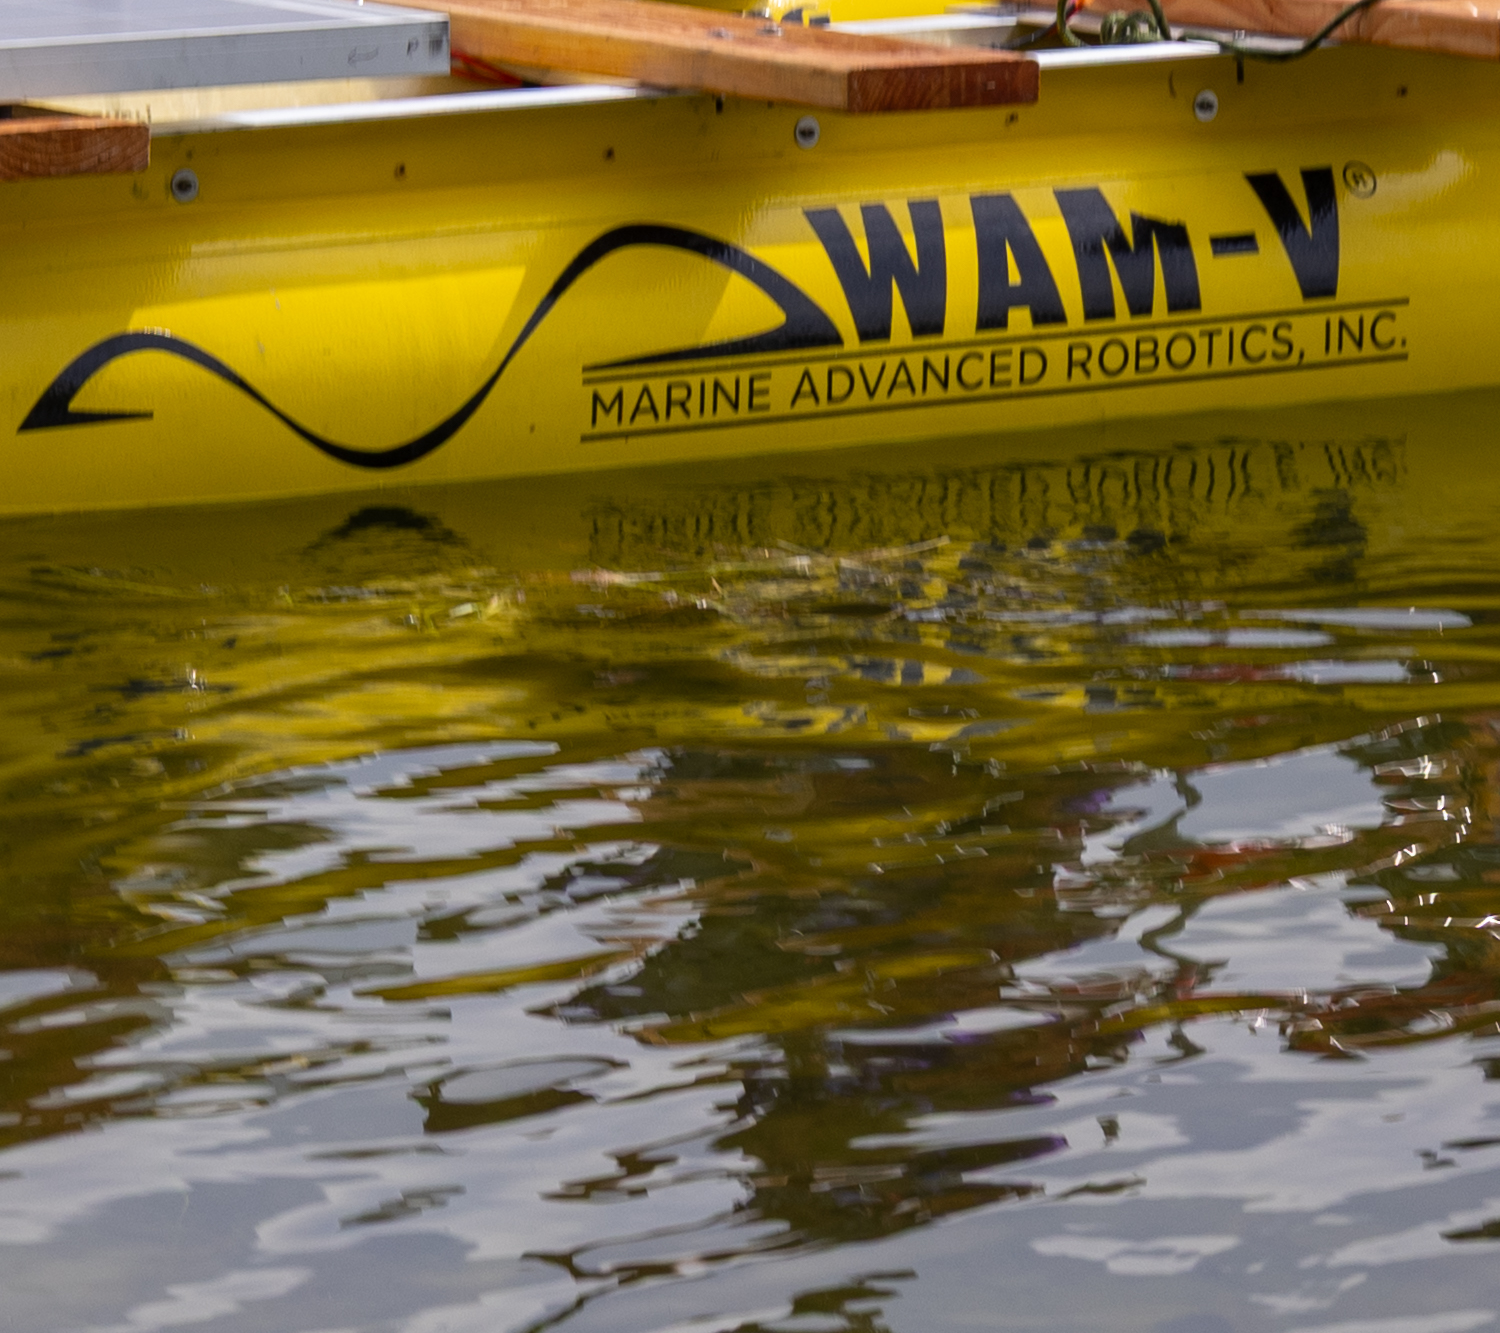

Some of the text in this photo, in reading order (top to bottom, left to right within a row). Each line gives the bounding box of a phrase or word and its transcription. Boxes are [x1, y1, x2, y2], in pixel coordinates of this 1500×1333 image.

[590, 310, 1408, 429] MARINE ADVANCED ROBOTICS, INC.
